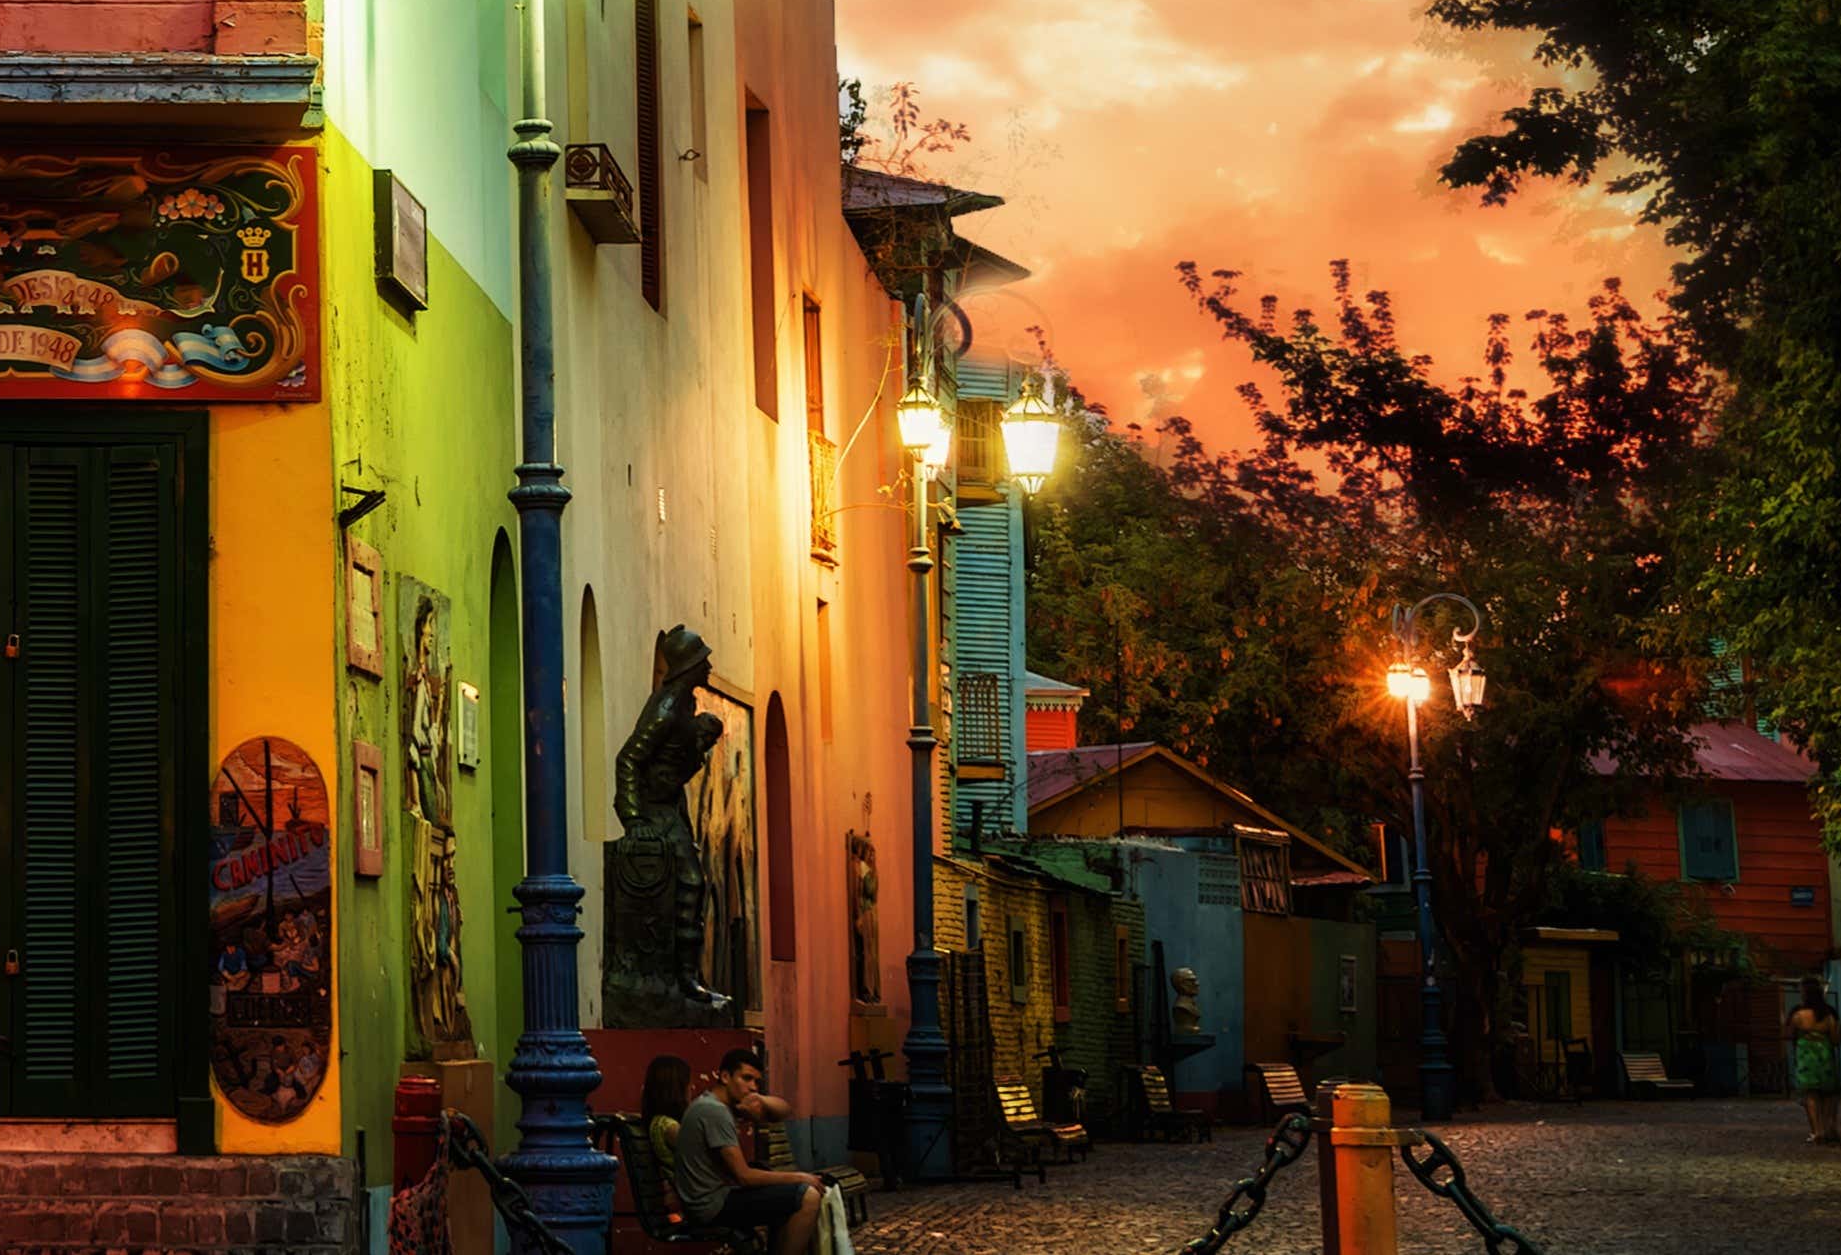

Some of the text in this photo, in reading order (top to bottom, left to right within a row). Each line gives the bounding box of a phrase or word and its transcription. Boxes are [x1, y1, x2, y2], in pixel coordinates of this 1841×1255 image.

[245, 252, 264, 278] H
[29, 331, 75, 364] 1948
[211, 823, 325, 892] CAMINITO
